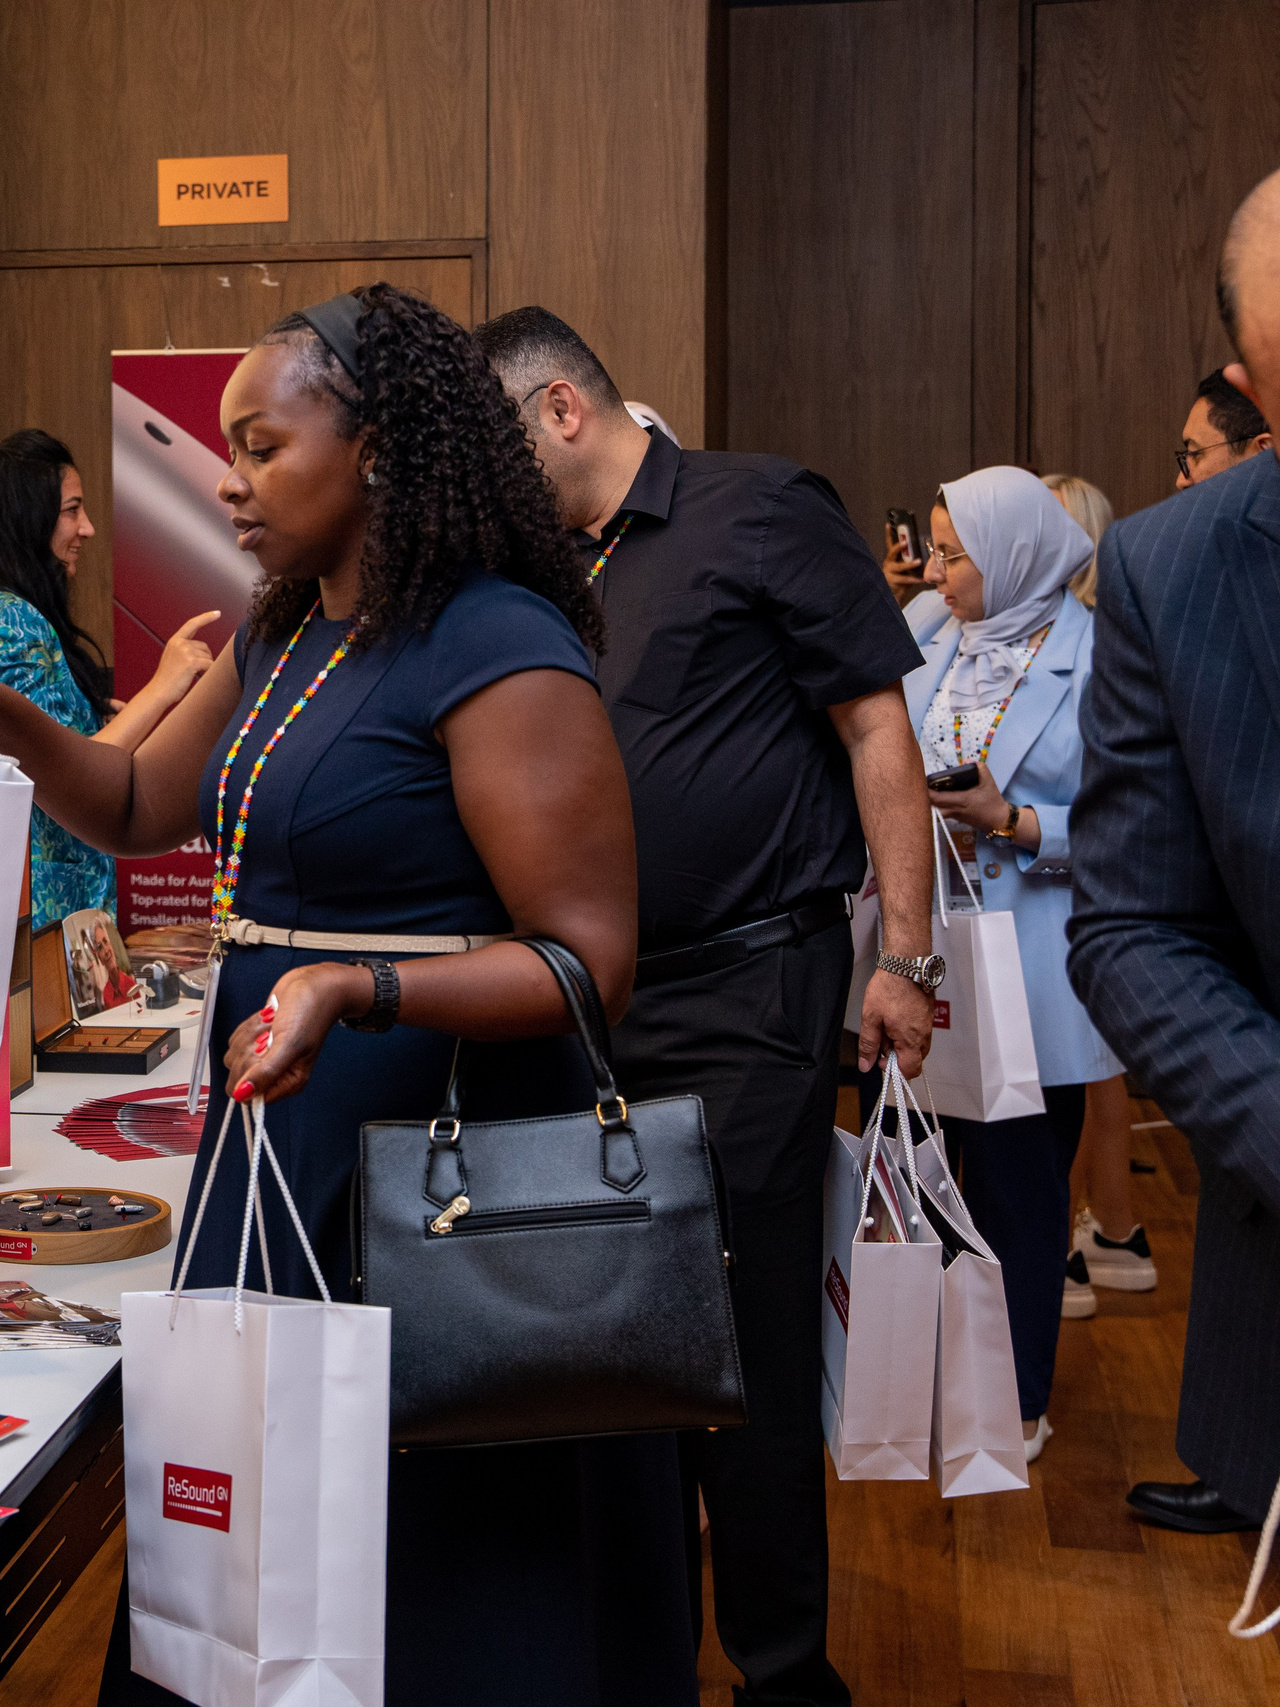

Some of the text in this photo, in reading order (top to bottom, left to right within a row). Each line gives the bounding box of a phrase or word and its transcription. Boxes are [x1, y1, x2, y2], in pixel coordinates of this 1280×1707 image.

[176, 181, 269, 200] PRIVATE
[130, 873, 165, 886] Made
[167, 873, 187, 886] for
[130, 893, 210, 908] Top-rated for
[130, 913, 211, 926] Smaller than
[16, 1241, 28, 1249] GN
[168, 1476, 228, 1504] ReSound GN
